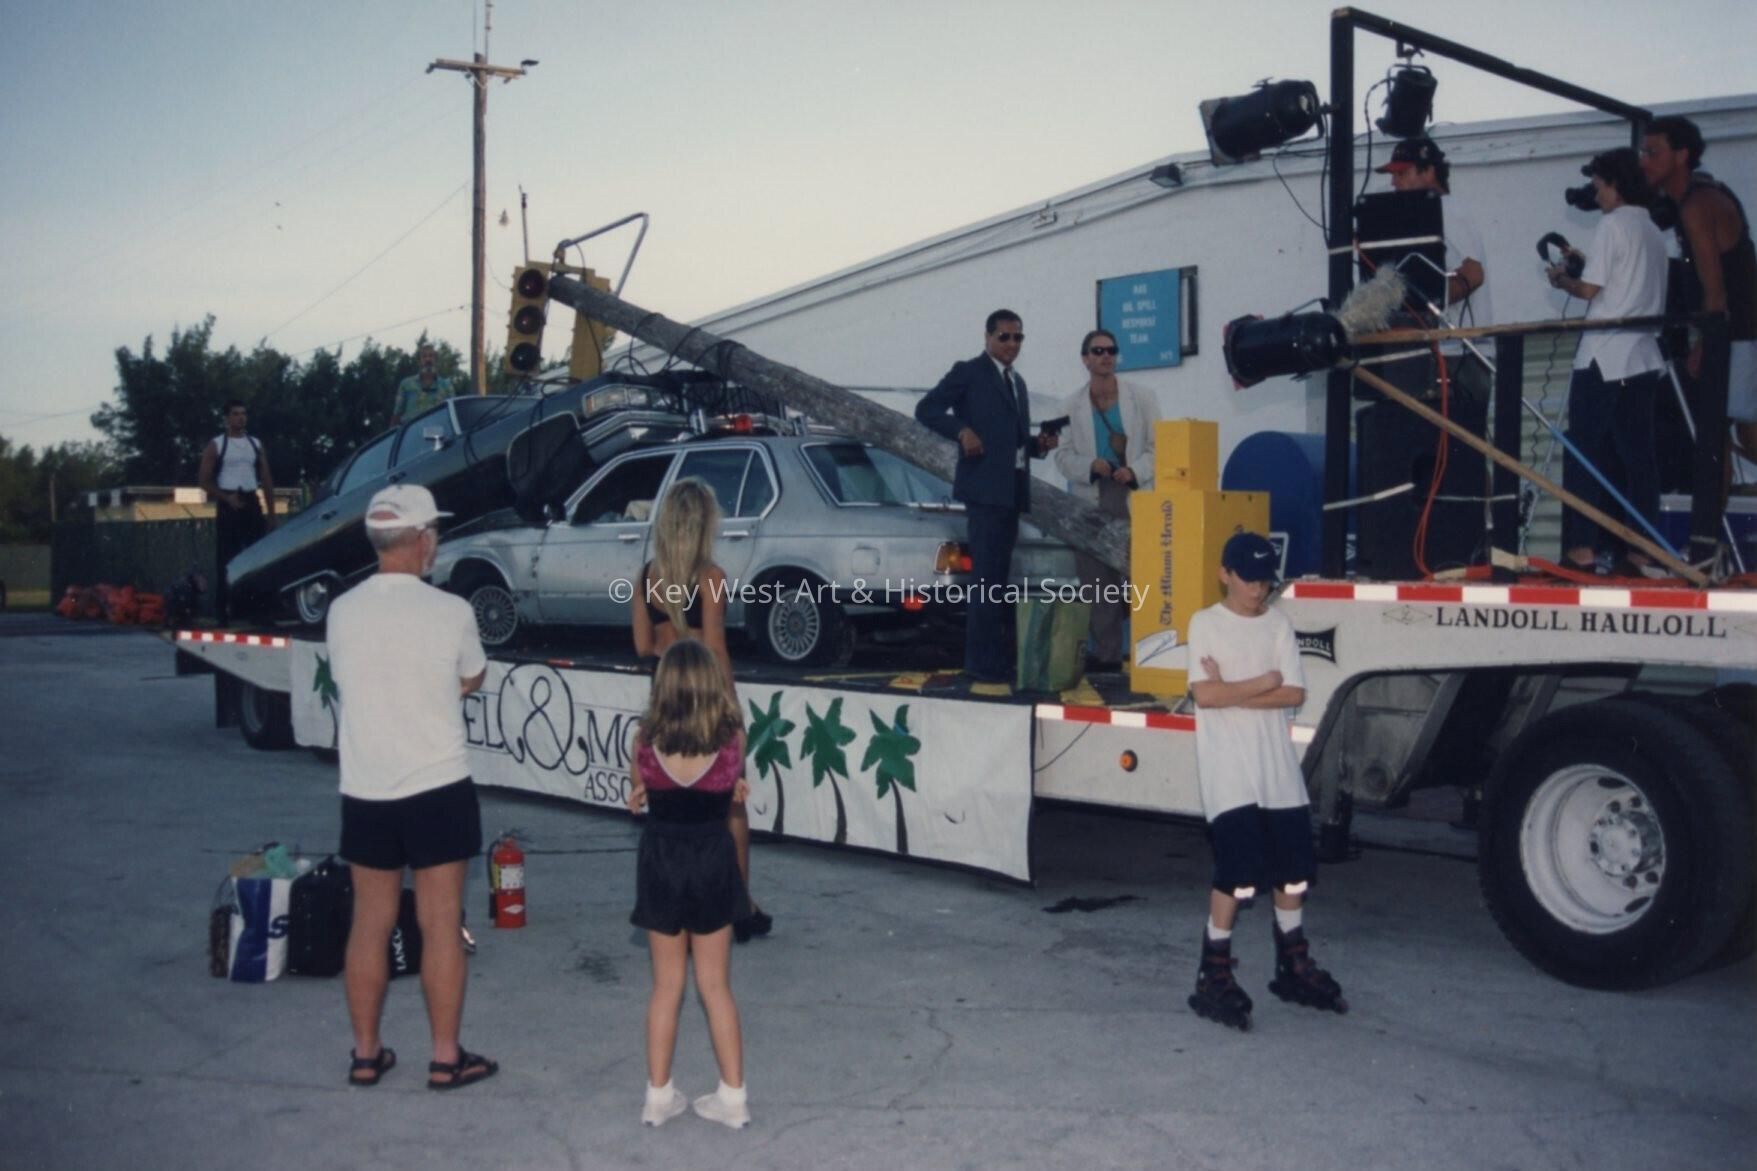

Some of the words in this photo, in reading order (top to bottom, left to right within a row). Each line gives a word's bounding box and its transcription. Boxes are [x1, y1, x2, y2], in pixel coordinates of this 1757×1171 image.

[1160, 500, 1174, 546] Herald
[1160, 551, 1173, 596] Miami
[1436, 606, 1568, 632] LANDOLL
[1580, 611, 1727, 640] HAULOLL
